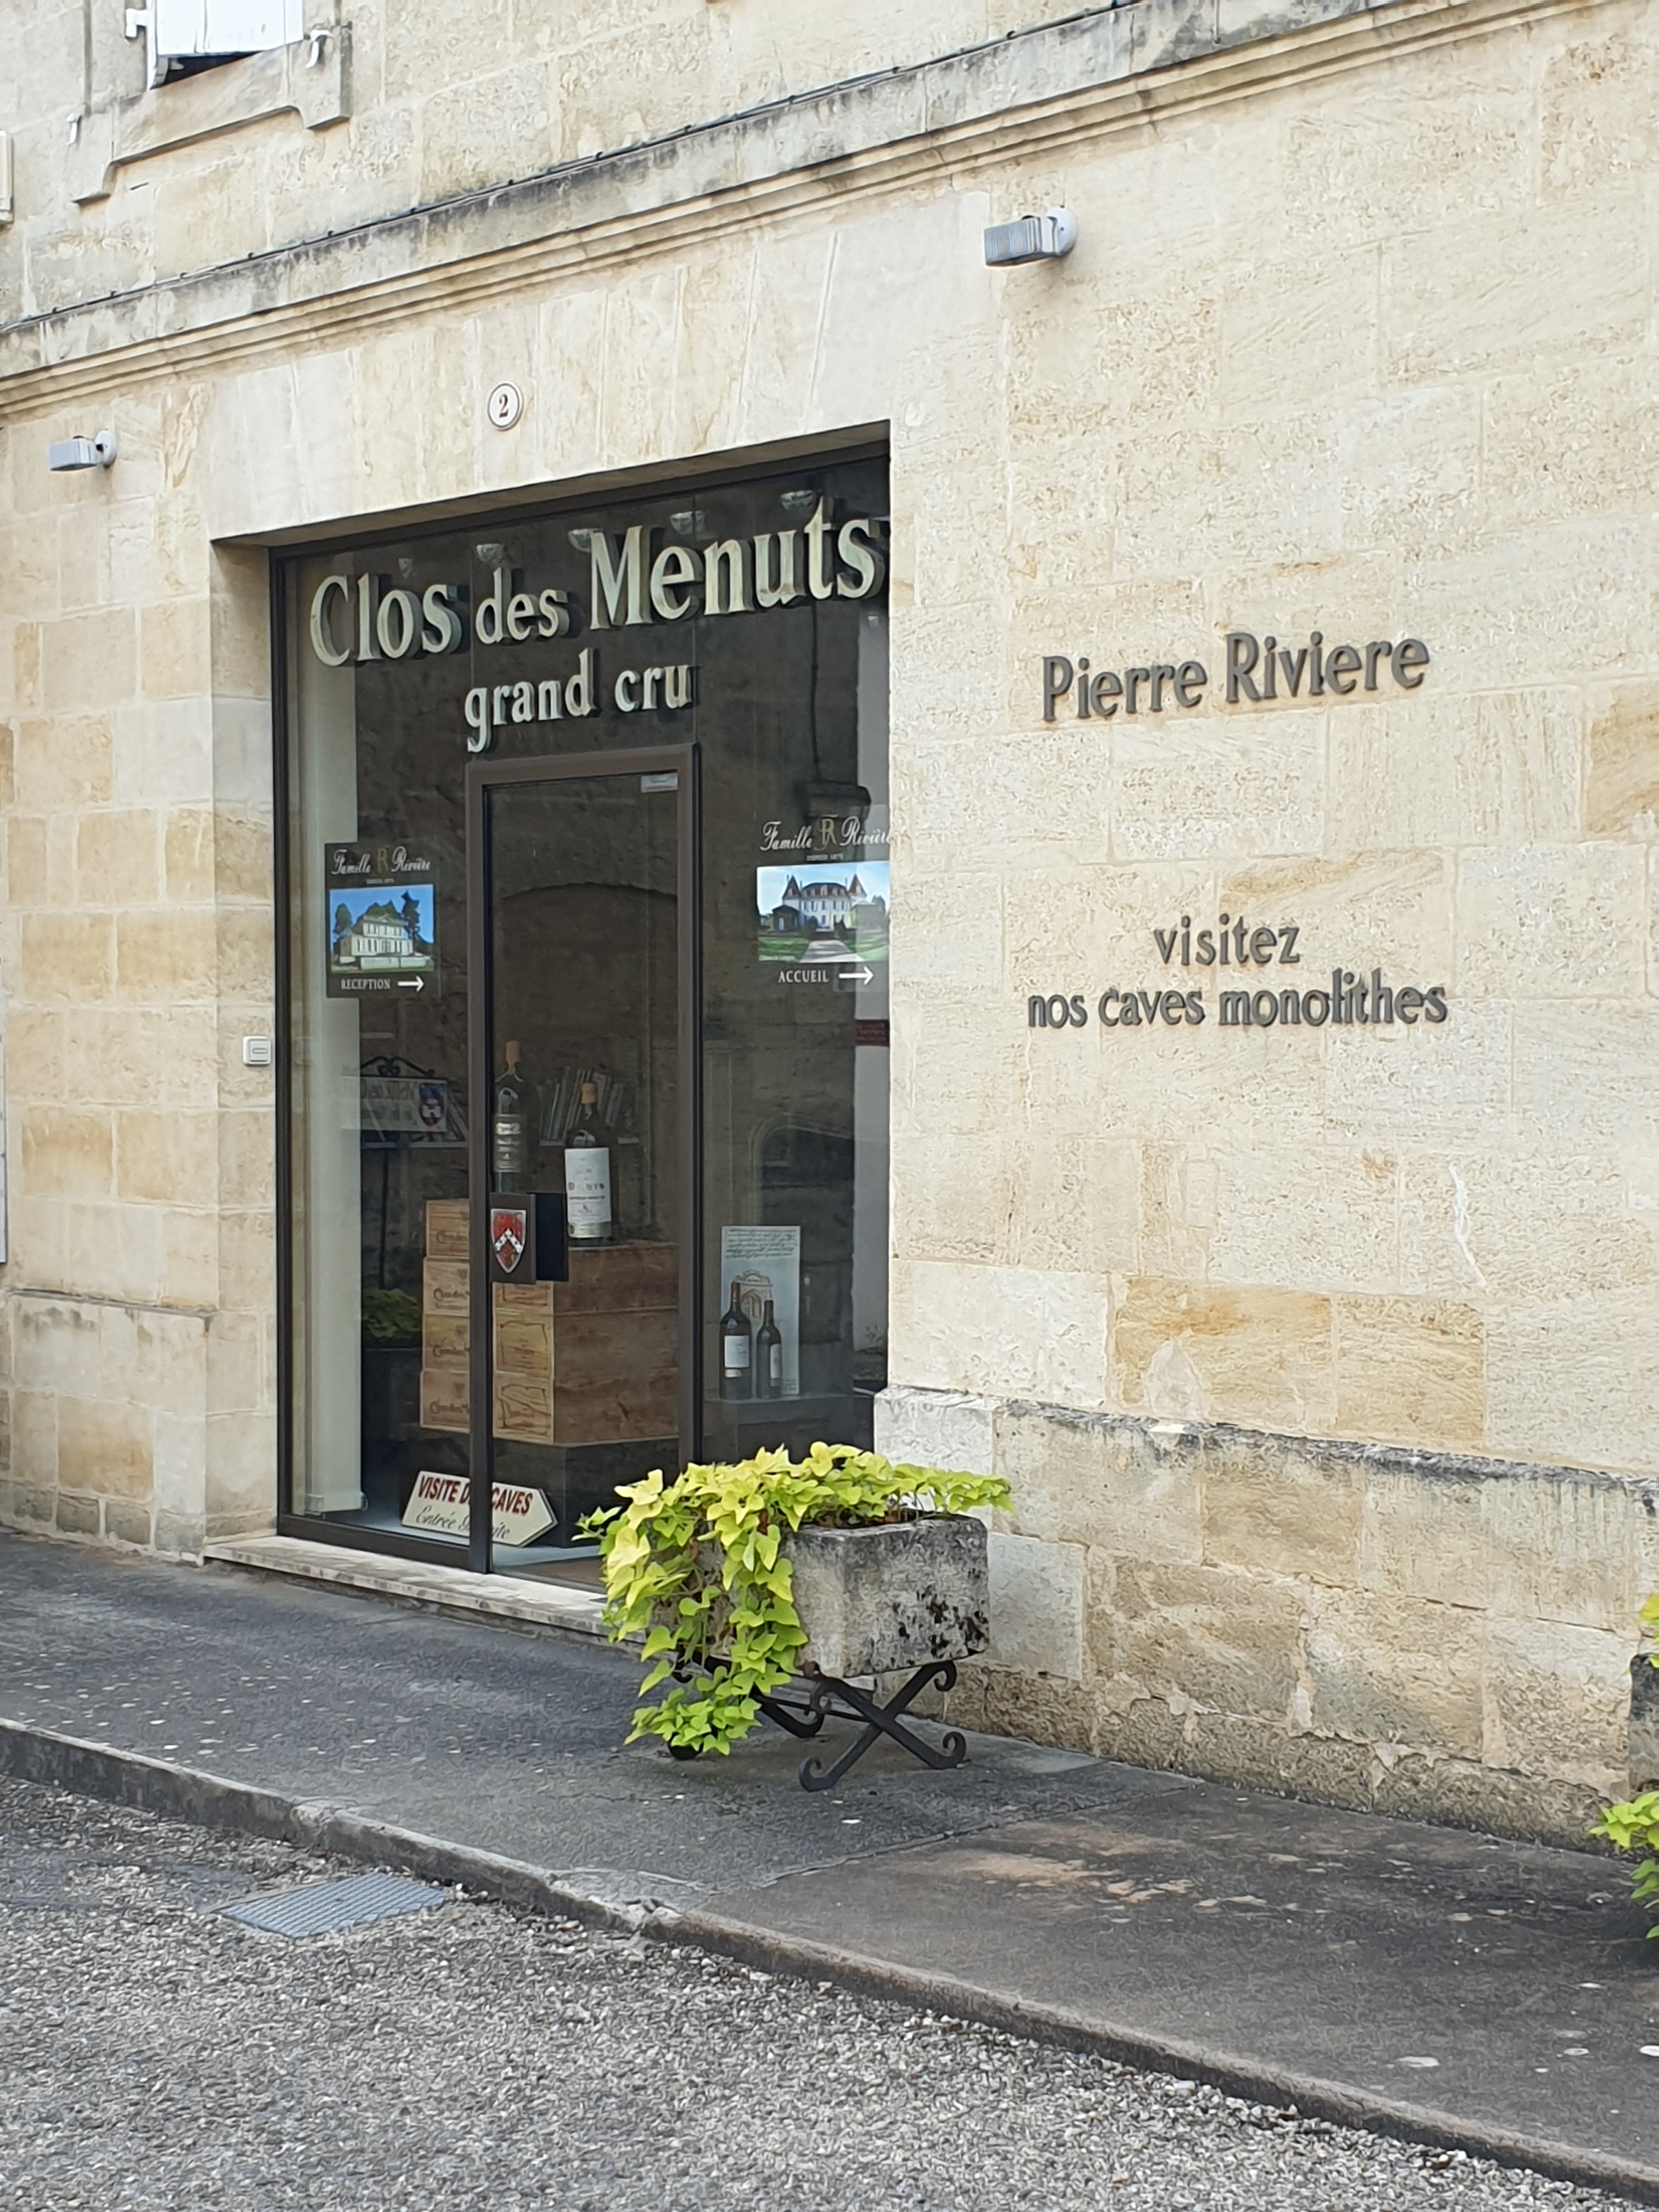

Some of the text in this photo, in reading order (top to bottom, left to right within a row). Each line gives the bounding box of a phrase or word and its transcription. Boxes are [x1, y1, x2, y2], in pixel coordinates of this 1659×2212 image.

[499, 393, 509, 418] 2
[310, 495, 885, 667] Clos des Menuts
[1042, 631, 1430, 722] Pierre Riviere
[464, 647, 695, 753] grand cru
[759, 821, 812, 850] Famille
[331, 849, 371, 874] Famille
[1154, 913, 1301, 966] visitez
[341, 979, 391, 990] RECEPTION
[777, 970, 830, 983] ACCUEIL
[1028, 968, 1448, 1029] nos caves monolithes
[417, 1475, 461, 1503] VISITE
[492, 1487, 533, 1515] CAVES
[415, 1505, 457, 1530] Entrée
